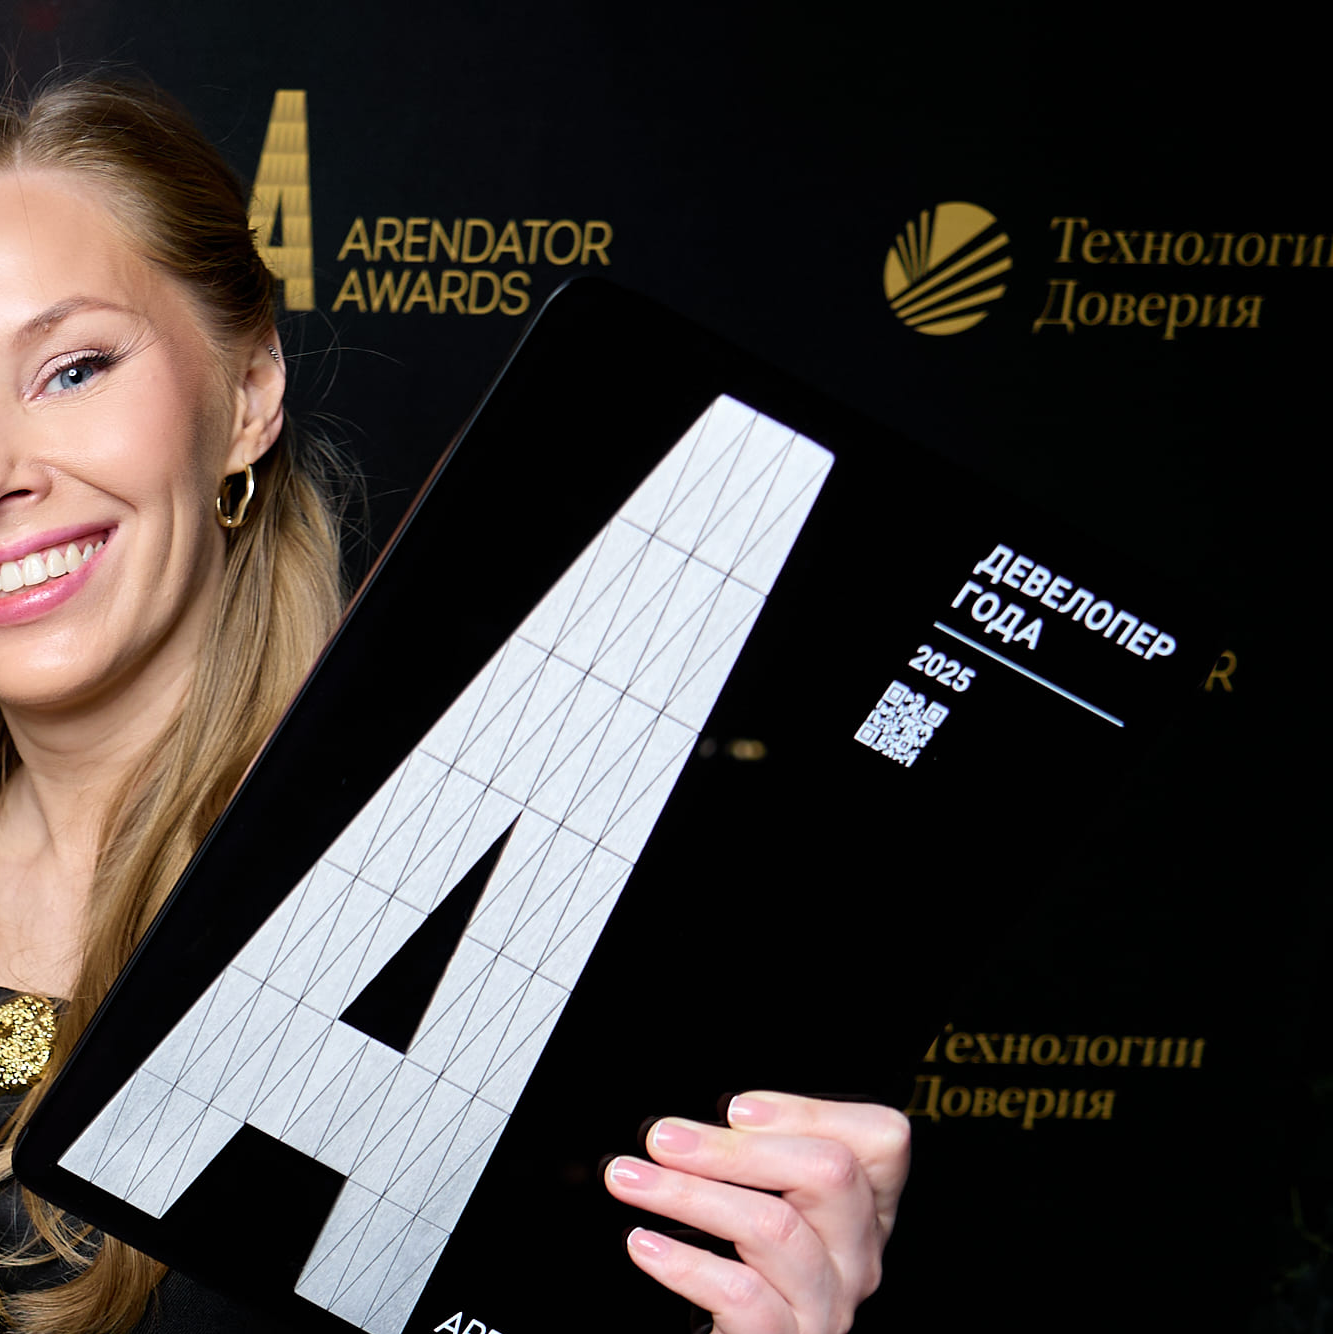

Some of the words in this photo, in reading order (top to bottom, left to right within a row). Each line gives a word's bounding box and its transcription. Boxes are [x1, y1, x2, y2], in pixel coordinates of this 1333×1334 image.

[337, 216, 613, 266] ARENDATOR
[331, 268, 532, 316] AWARDS
[1033, 279, 1265, 340] Доверия
[950, 579, 1045, 651] ГОДА
[972, 543, 1177, 661] ДЕВЕЛОПЕР
[908, 643, 978, 693] 2025
[903, 1074, 1116, 1130] Доверия
